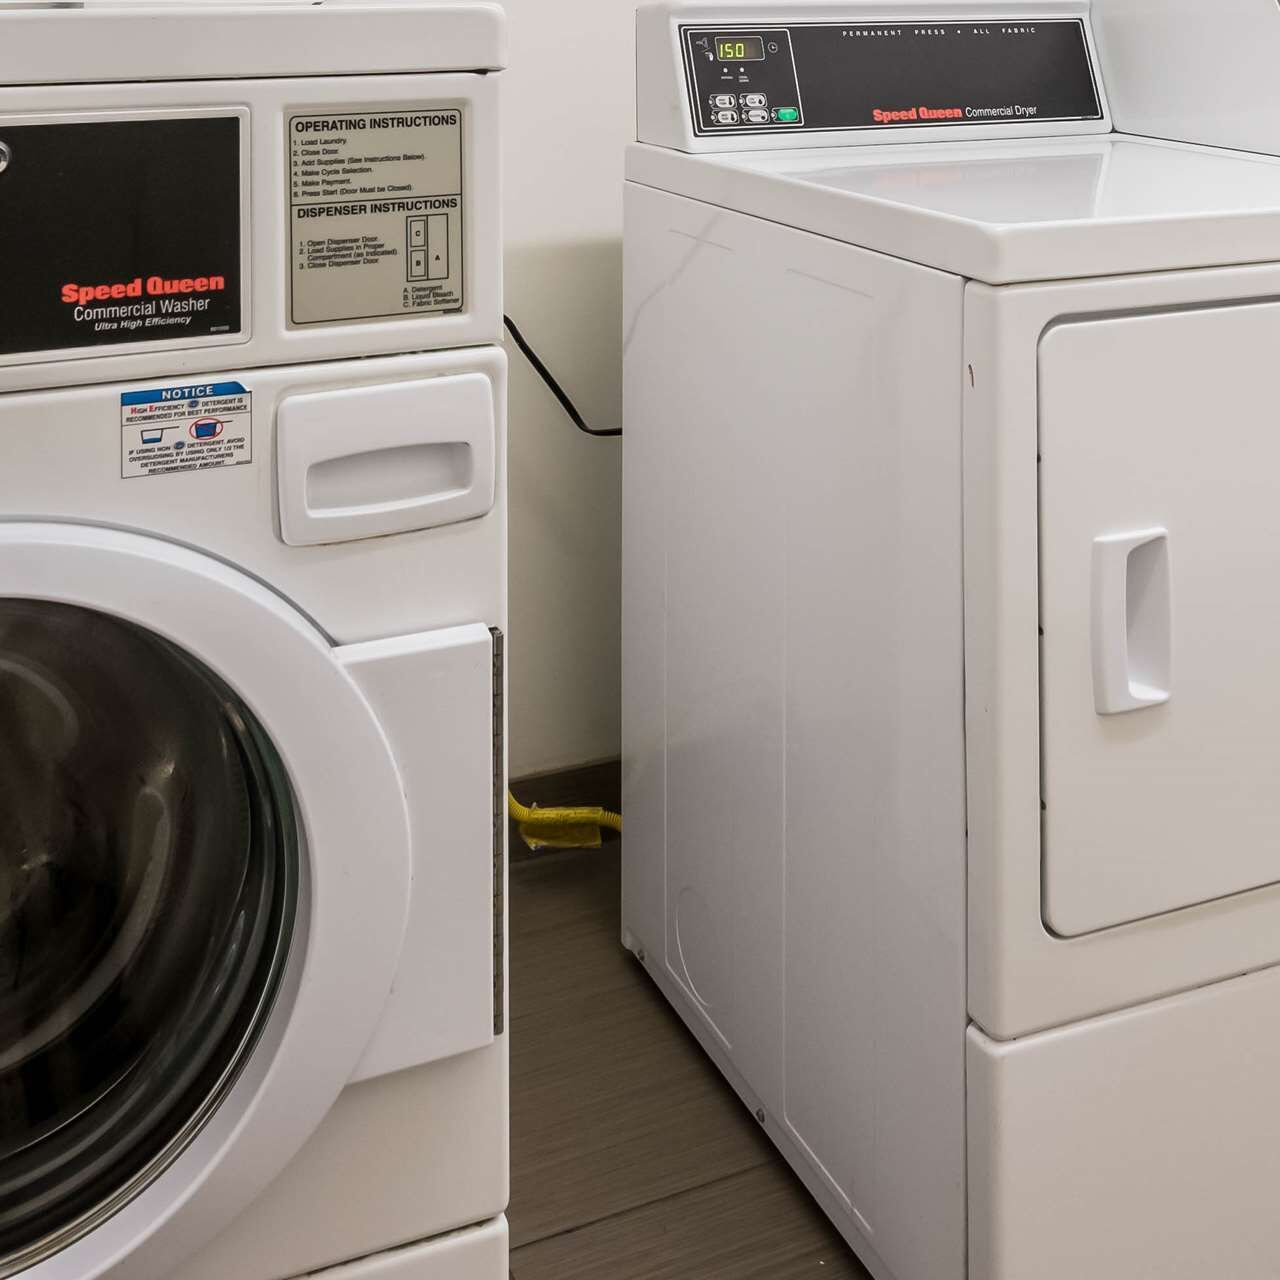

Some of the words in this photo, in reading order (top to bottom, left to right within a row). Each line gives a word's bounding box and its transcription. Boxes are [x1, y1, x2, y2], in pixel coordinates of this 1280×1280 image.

[842, 29, 902, 37] PERMANENT
[914, 28, 946, 36] PRESS
[720, 43, 744, 58] 150
[873, 107, 917, 123] Speed
[919, 106, 962, 119] Queen
[965, 106, 1013, 118] Commercial
[1015, 105, 1037, 118] Dryer
[295, 119, 366, 133] OPERATING
[370, 115, 457, 129] INSTRUCTIONS
[320, 137, 347, 146] Laundry
[301, 149, 320, 157] Close
[317, 158, 345, 167] Supplies
[364, 154, 401, 163] Instructions
[321, 168, 340, 176] Cycle
[340, 187, 357, 196] (Door
[297, 205, 367, 219] DISPENSER
[370, 199, 458, 213] INSTRUCTIONS
[307, 239, 326, 248] Open
[327, 237, 360, 246] Dispenser
[307, 247, 324, 255] Load
[326, 245, 354, 254] Supplies
[363, 242, 385, 251] Proper
[307, 252, 352, 262] Compartment
[307, 261, 327, 269] Close
[328, 259, 361, 268] Dispenser
[61, 278, 142, 305] Speed
[146, 275, 225, 296] Queen
[412, 285, 442, 294] Detergent
[412, 292, 431, 301] Liquid
[433, 290, 453, 298] Bleach
[412, 299, 432, 308] Fabric
[434, 297, 460, 305] Softener
[74, 301, 156, 321] Commercial
[160, 297, 211, 314] Washer
[94, 321, 118, 331] Ultra
[120, 320, 143, 330] High
[145, 316, 192, 327] Efficiency
[162, 386, 214, 400] NOTICE
[202, 398, 237, 407] DETERGENT
[126, 412, 172, 422] RECOMMENDED
[204, 405, 247, 414] PERFORMANCE
